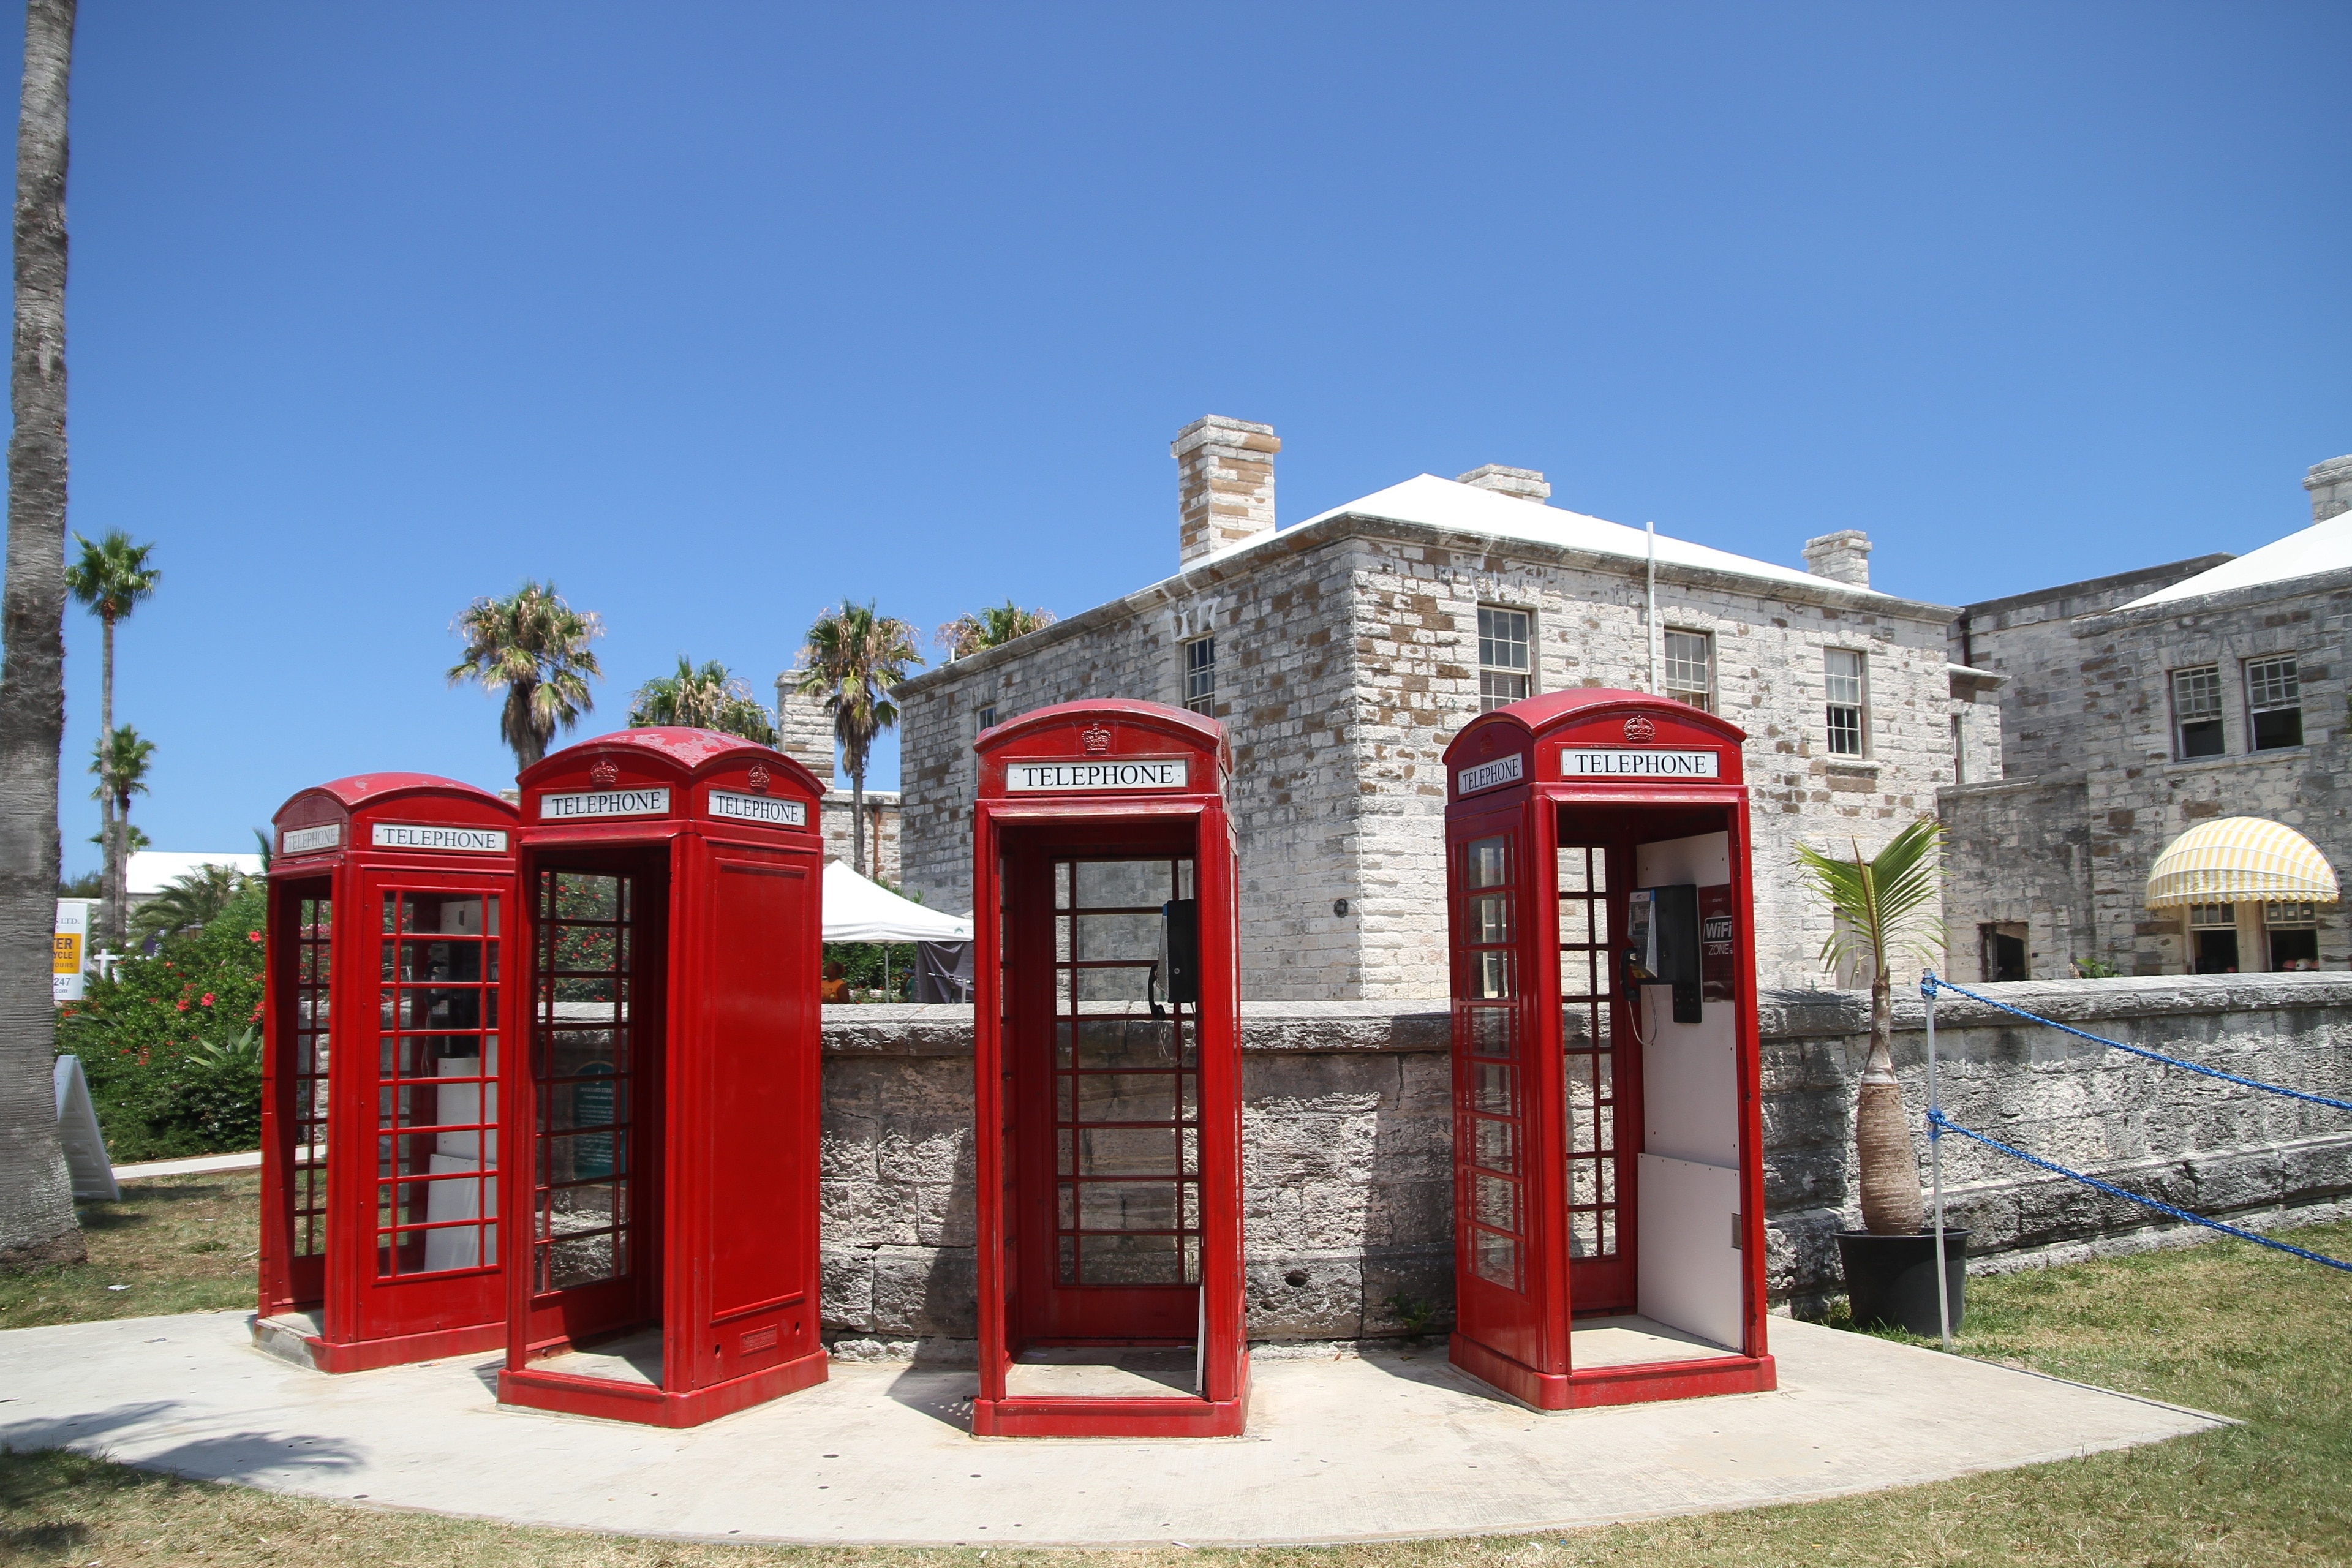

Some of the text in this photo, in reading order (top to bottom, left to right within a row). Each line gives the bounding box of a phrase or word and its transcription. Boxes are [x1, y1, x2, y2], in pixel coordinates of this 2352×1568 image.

[1023, 764, 1174, 786] TELEPHONE
[1462, 758, 1519, 791] TELEPHONE
[1575, 754, 1707, 774] TELEPHONE
[552, 791, 661, 815] TELEPHONE
[717, 795, 799, 822] TELEPHONE
[288, 828, 335, 851] TELEPHONE
[383, 828, 496, 848] TELEPHONE
[1706, 921, 1732, 938] WiFi
[1708, 944, 1729, 955] ZONE
